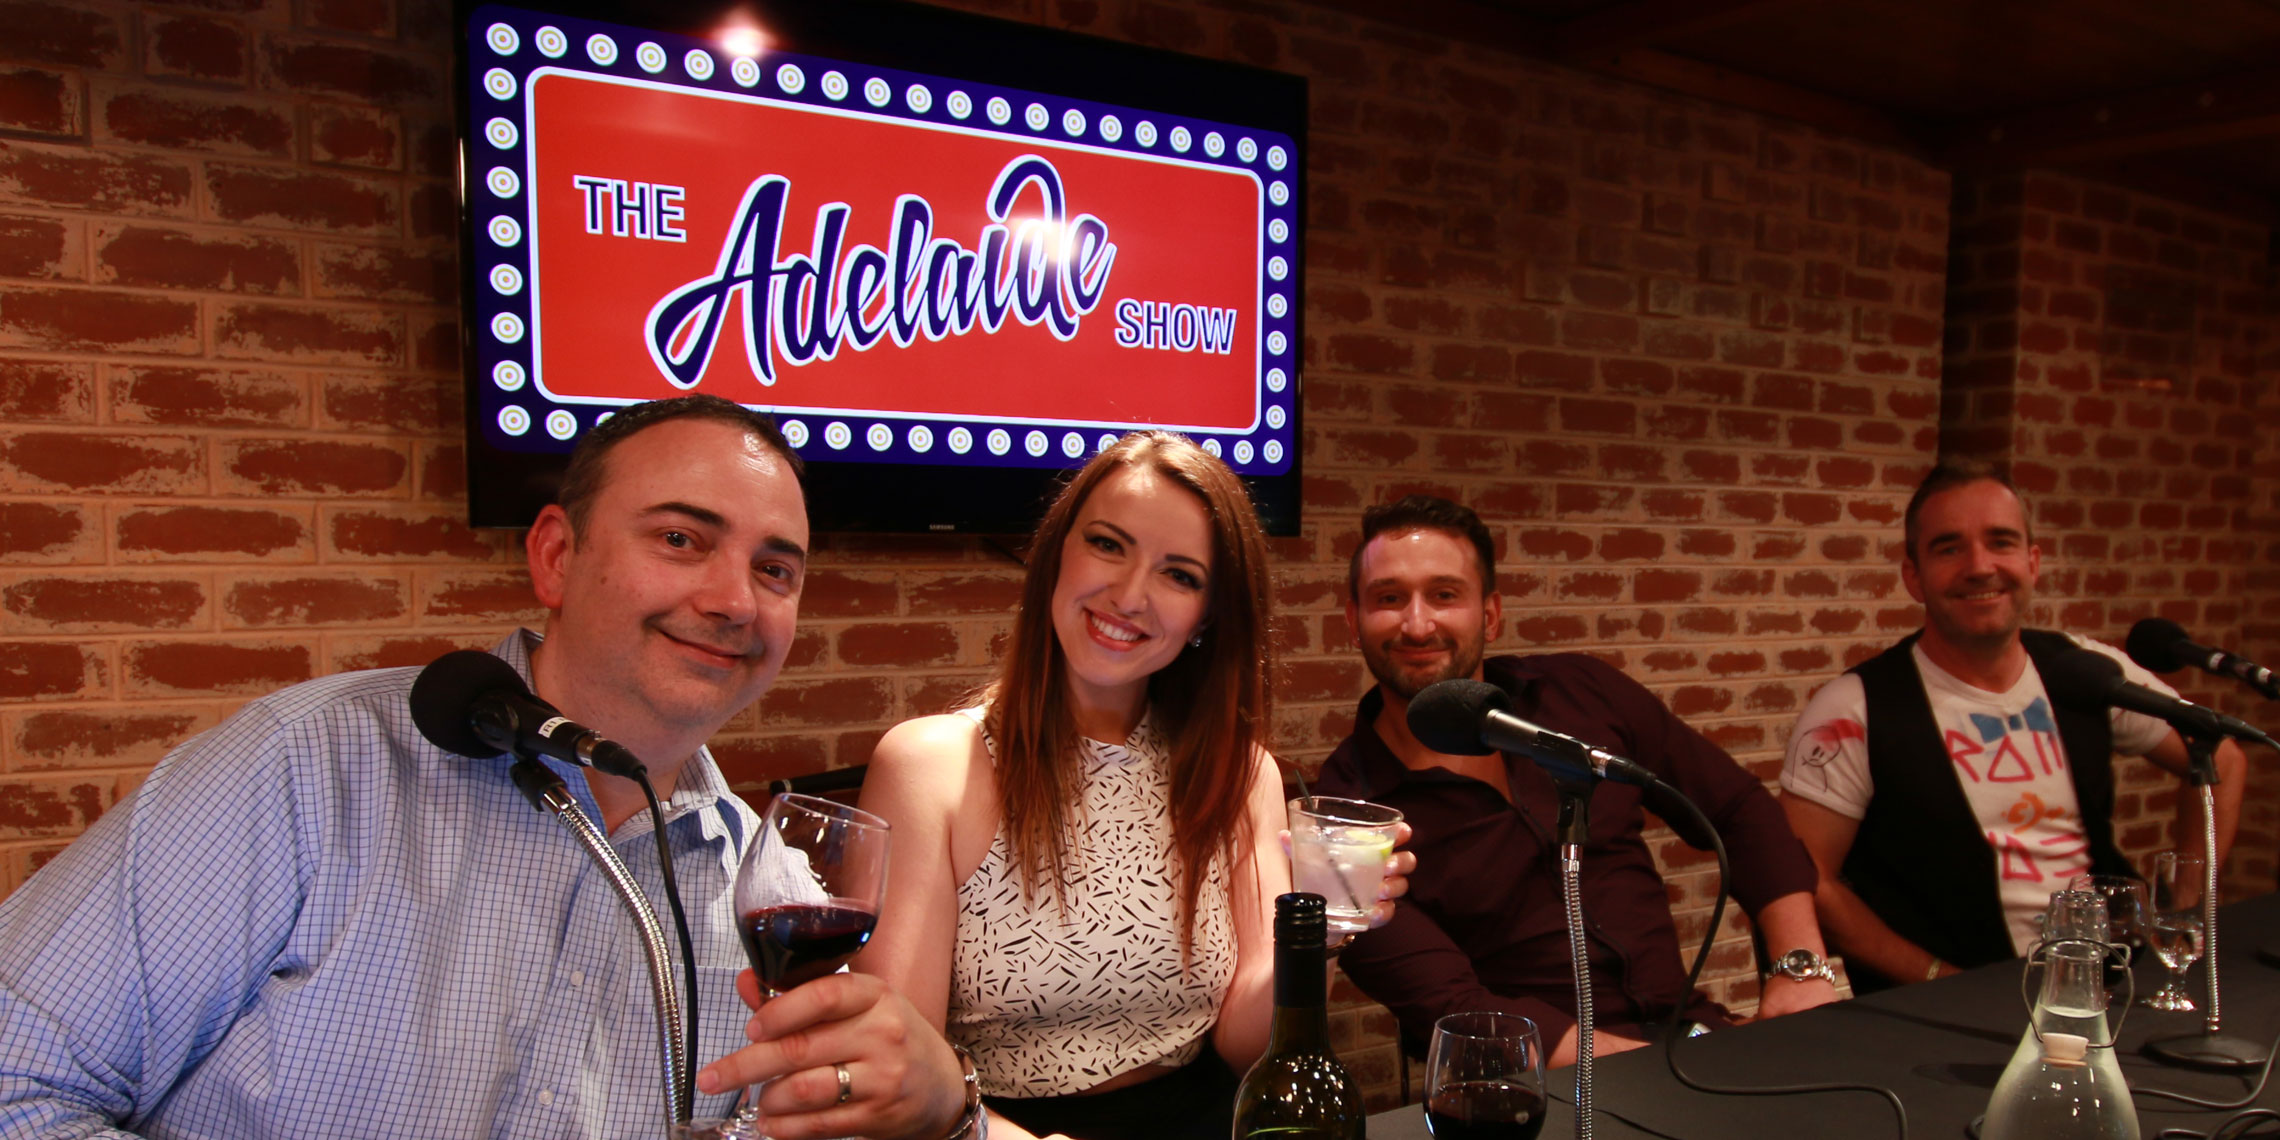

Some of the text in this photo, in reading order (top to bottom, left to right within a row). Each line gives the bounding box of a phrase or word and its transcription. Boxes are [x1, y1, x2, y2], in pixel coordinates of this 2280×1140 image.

[573, 153, 1238, 390] THE Adelaide SHOW
